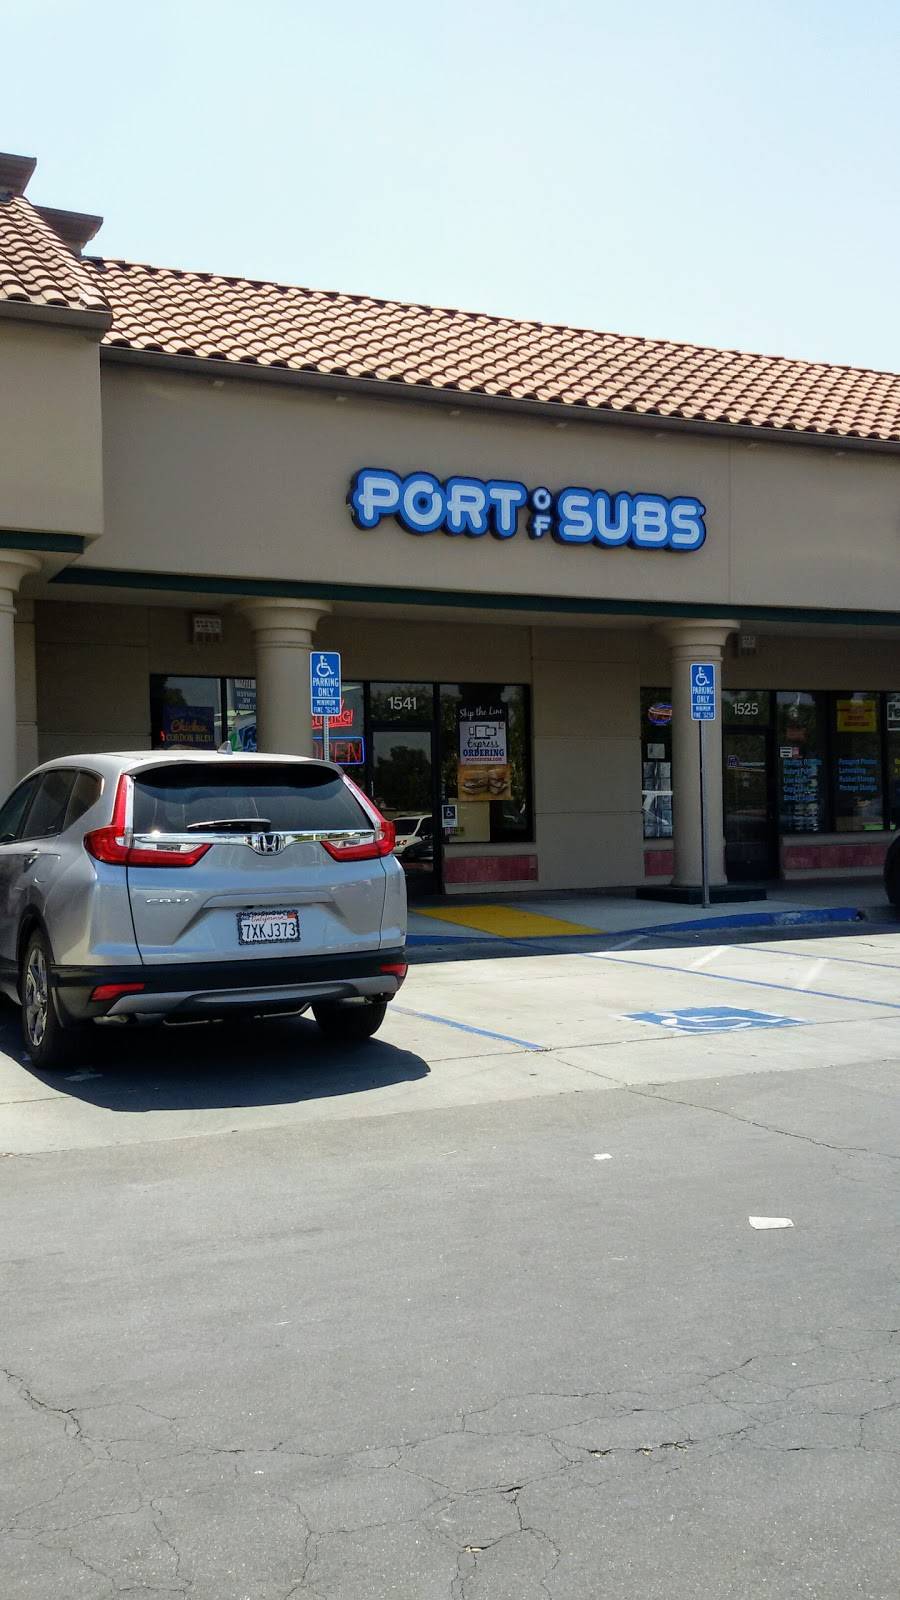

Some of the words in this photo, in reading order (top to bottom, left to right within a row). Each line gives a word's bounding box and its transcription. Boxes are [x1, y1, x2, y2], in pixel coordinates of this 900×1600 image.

[353, 471, 526, 537] PORT
[531, 488, 551, 537] OF
[556, 489, 704, 549] SUBS
[313, 677, 339, 687] PARKING
[318, 688, 334, 697] ONLY
[692, 686, 714, 695] PARKING
[387, 696, 417, 710] 1541
[696, 695, 710, 704] ONLY
[459, 707, 474, 720] Skip
[475, 705, 487, 716] the
[488, 706, 503, 716] Line
[732, 702, 759, 715] 1525
[467, 737, 500, 751] Express
[463, 748, 505, 757] ORDERING
[251, 915, 287, 923] California
[243, 922, 296, 940] 7XKJ373
